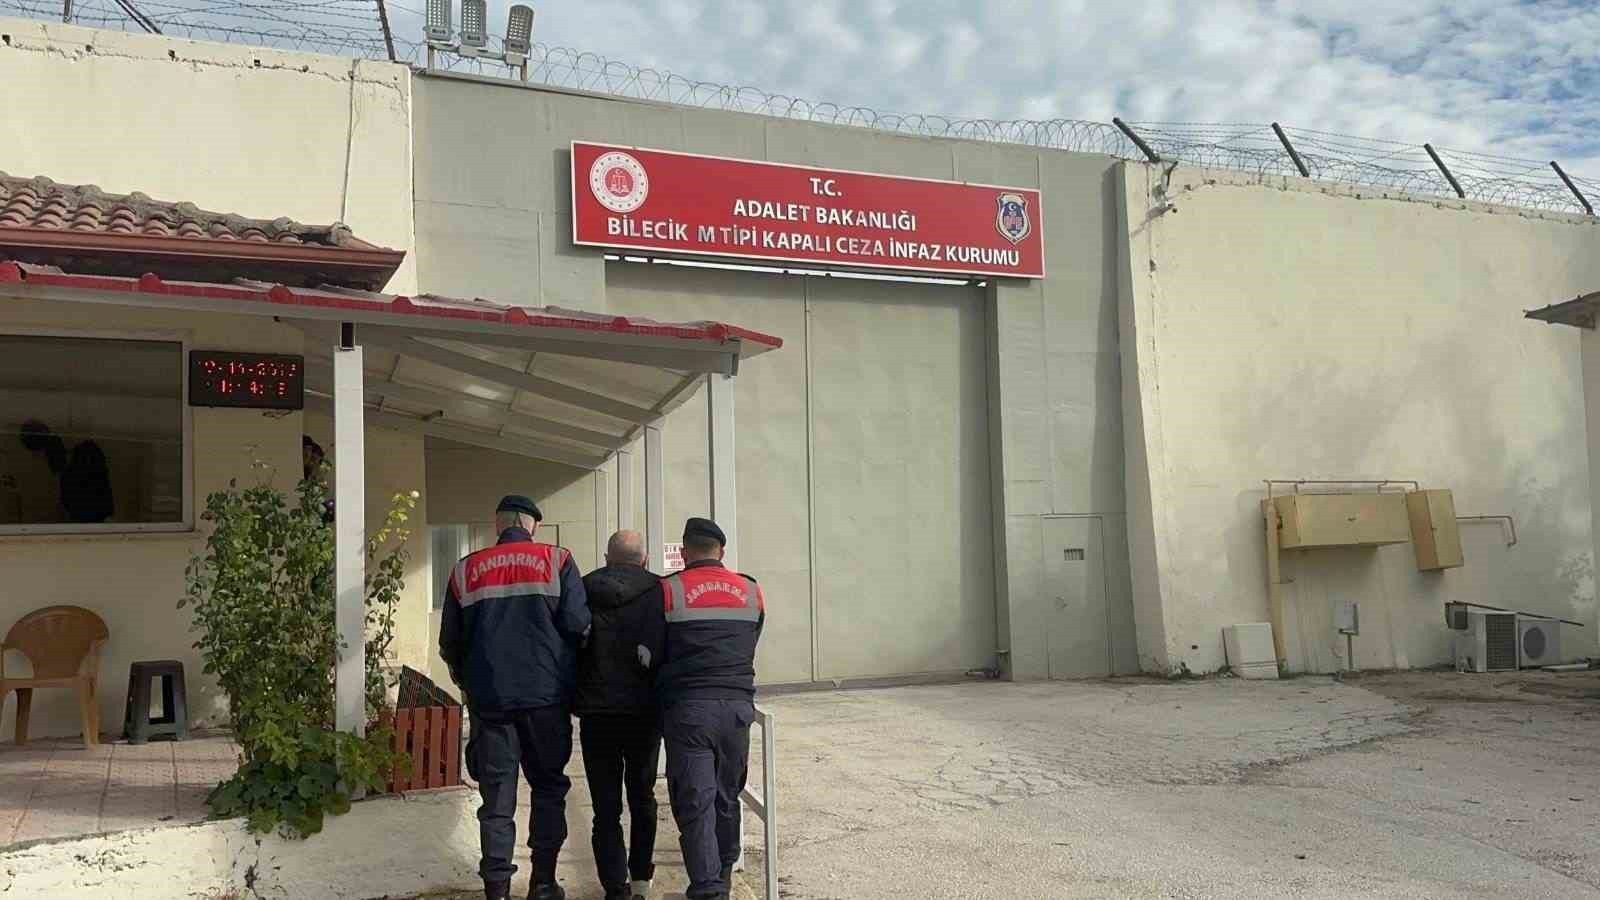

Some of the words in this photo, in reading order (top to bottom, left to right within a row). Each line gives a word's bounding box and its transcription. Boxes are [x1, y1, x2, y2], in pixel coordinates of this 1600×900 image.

[809, 177, 843, 197] T.C.
[733, 199, 811, 223] ADALET
[815, 206, 917, 232] BAKANLIĞI
[607, 214, 689, 242] BİLECİK
[698, 225, 715, 244] M
[719, 224, 757, 247] TİPİ
[762, 230, 831, 254] KAPALI
[836, 236, 885, 257] CEZA
[889, 236, 942, 262] İNFAZ
[946, 245, 1020, 267] KURUMU
[471, 552, 547, 583] JANDARMA
